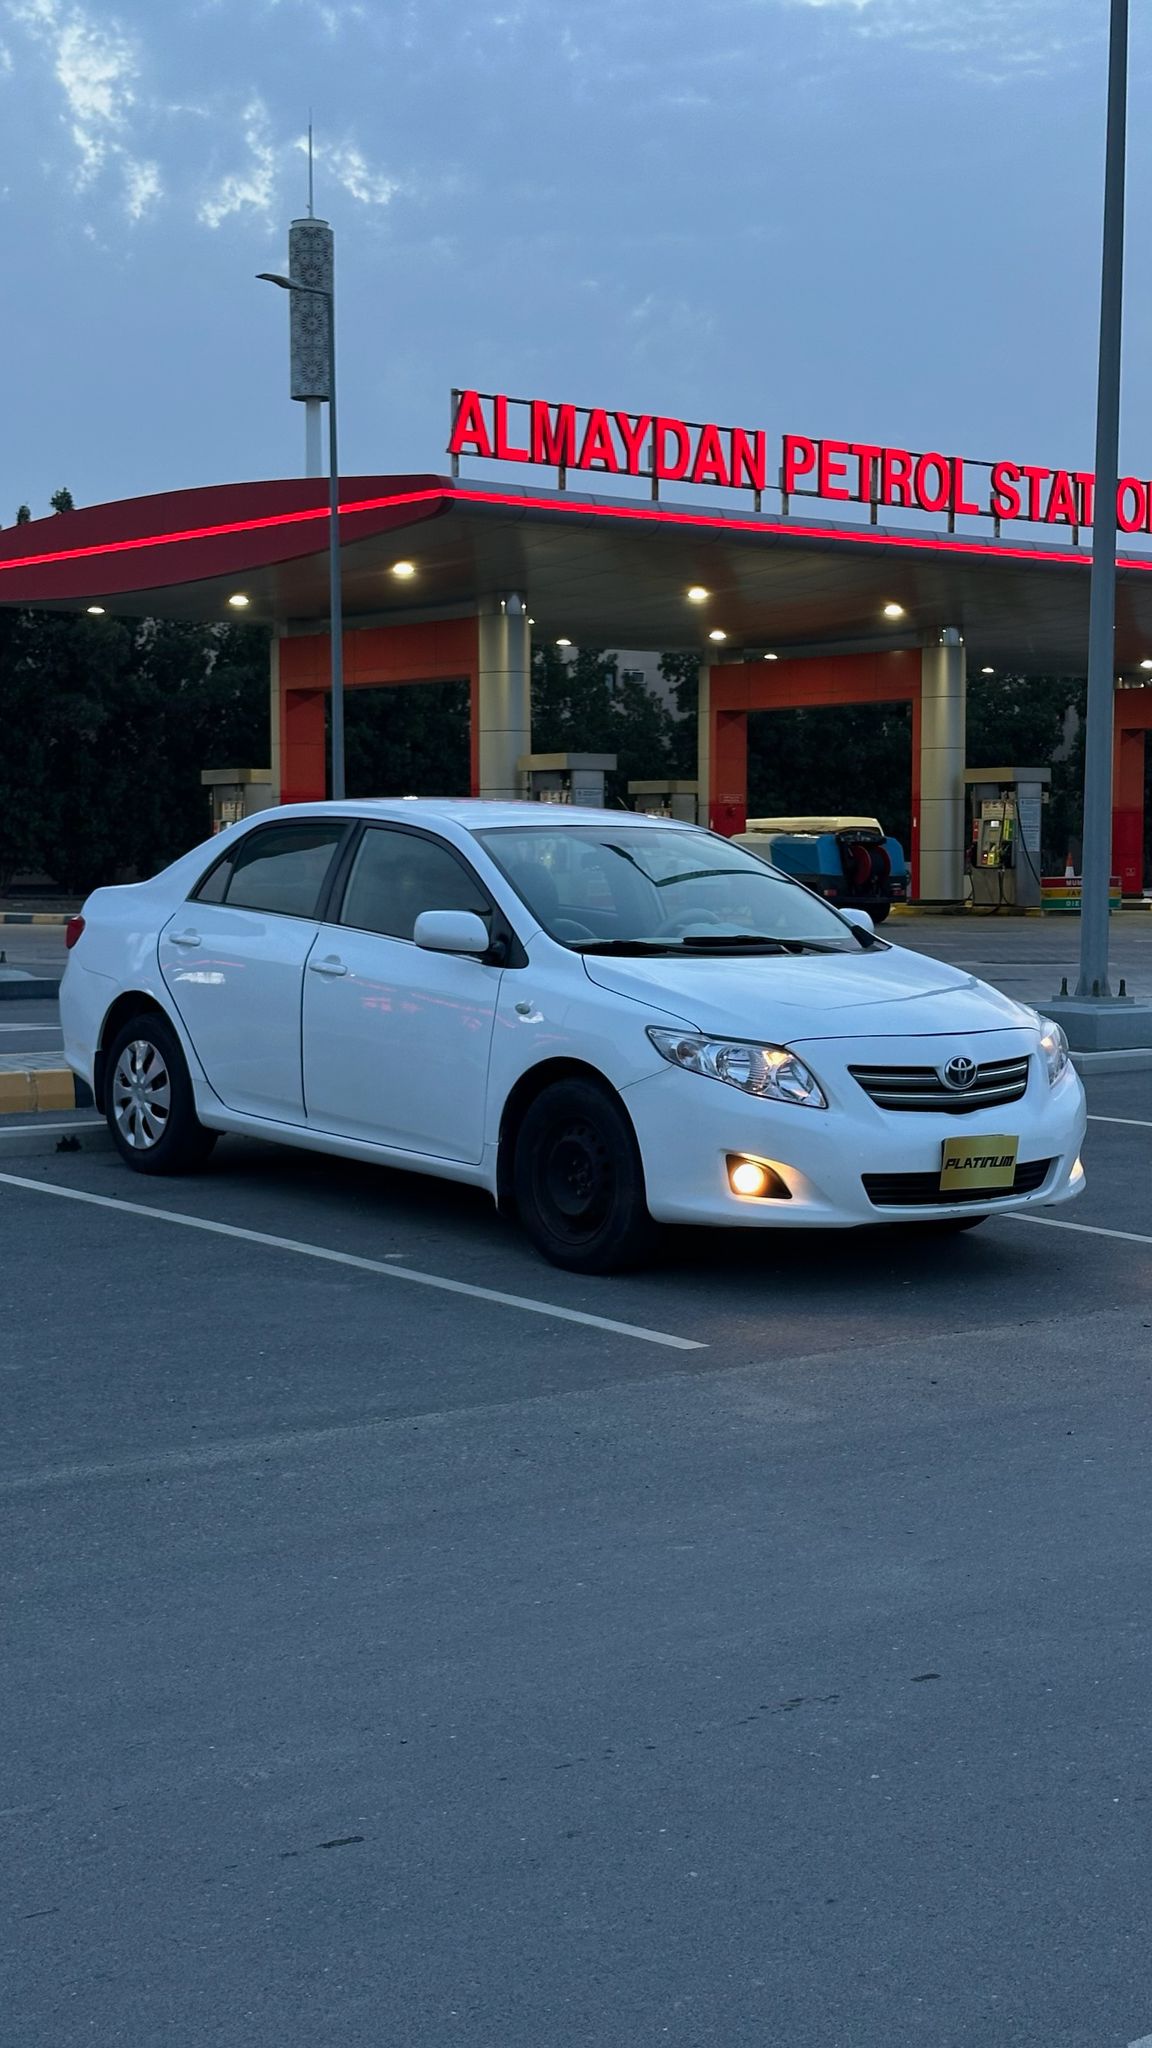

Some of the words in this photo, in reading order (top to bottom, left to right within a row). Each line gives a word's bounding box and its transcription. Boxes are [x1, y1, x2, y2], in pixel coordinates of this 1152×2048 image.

[449, 390, 767, 491] ALMAYDAN
[784, 434, 980, 515] PETROL
[990, 461, 1152, 533] STATO
[944, 1156, 1015, 1170] PLATINUM
